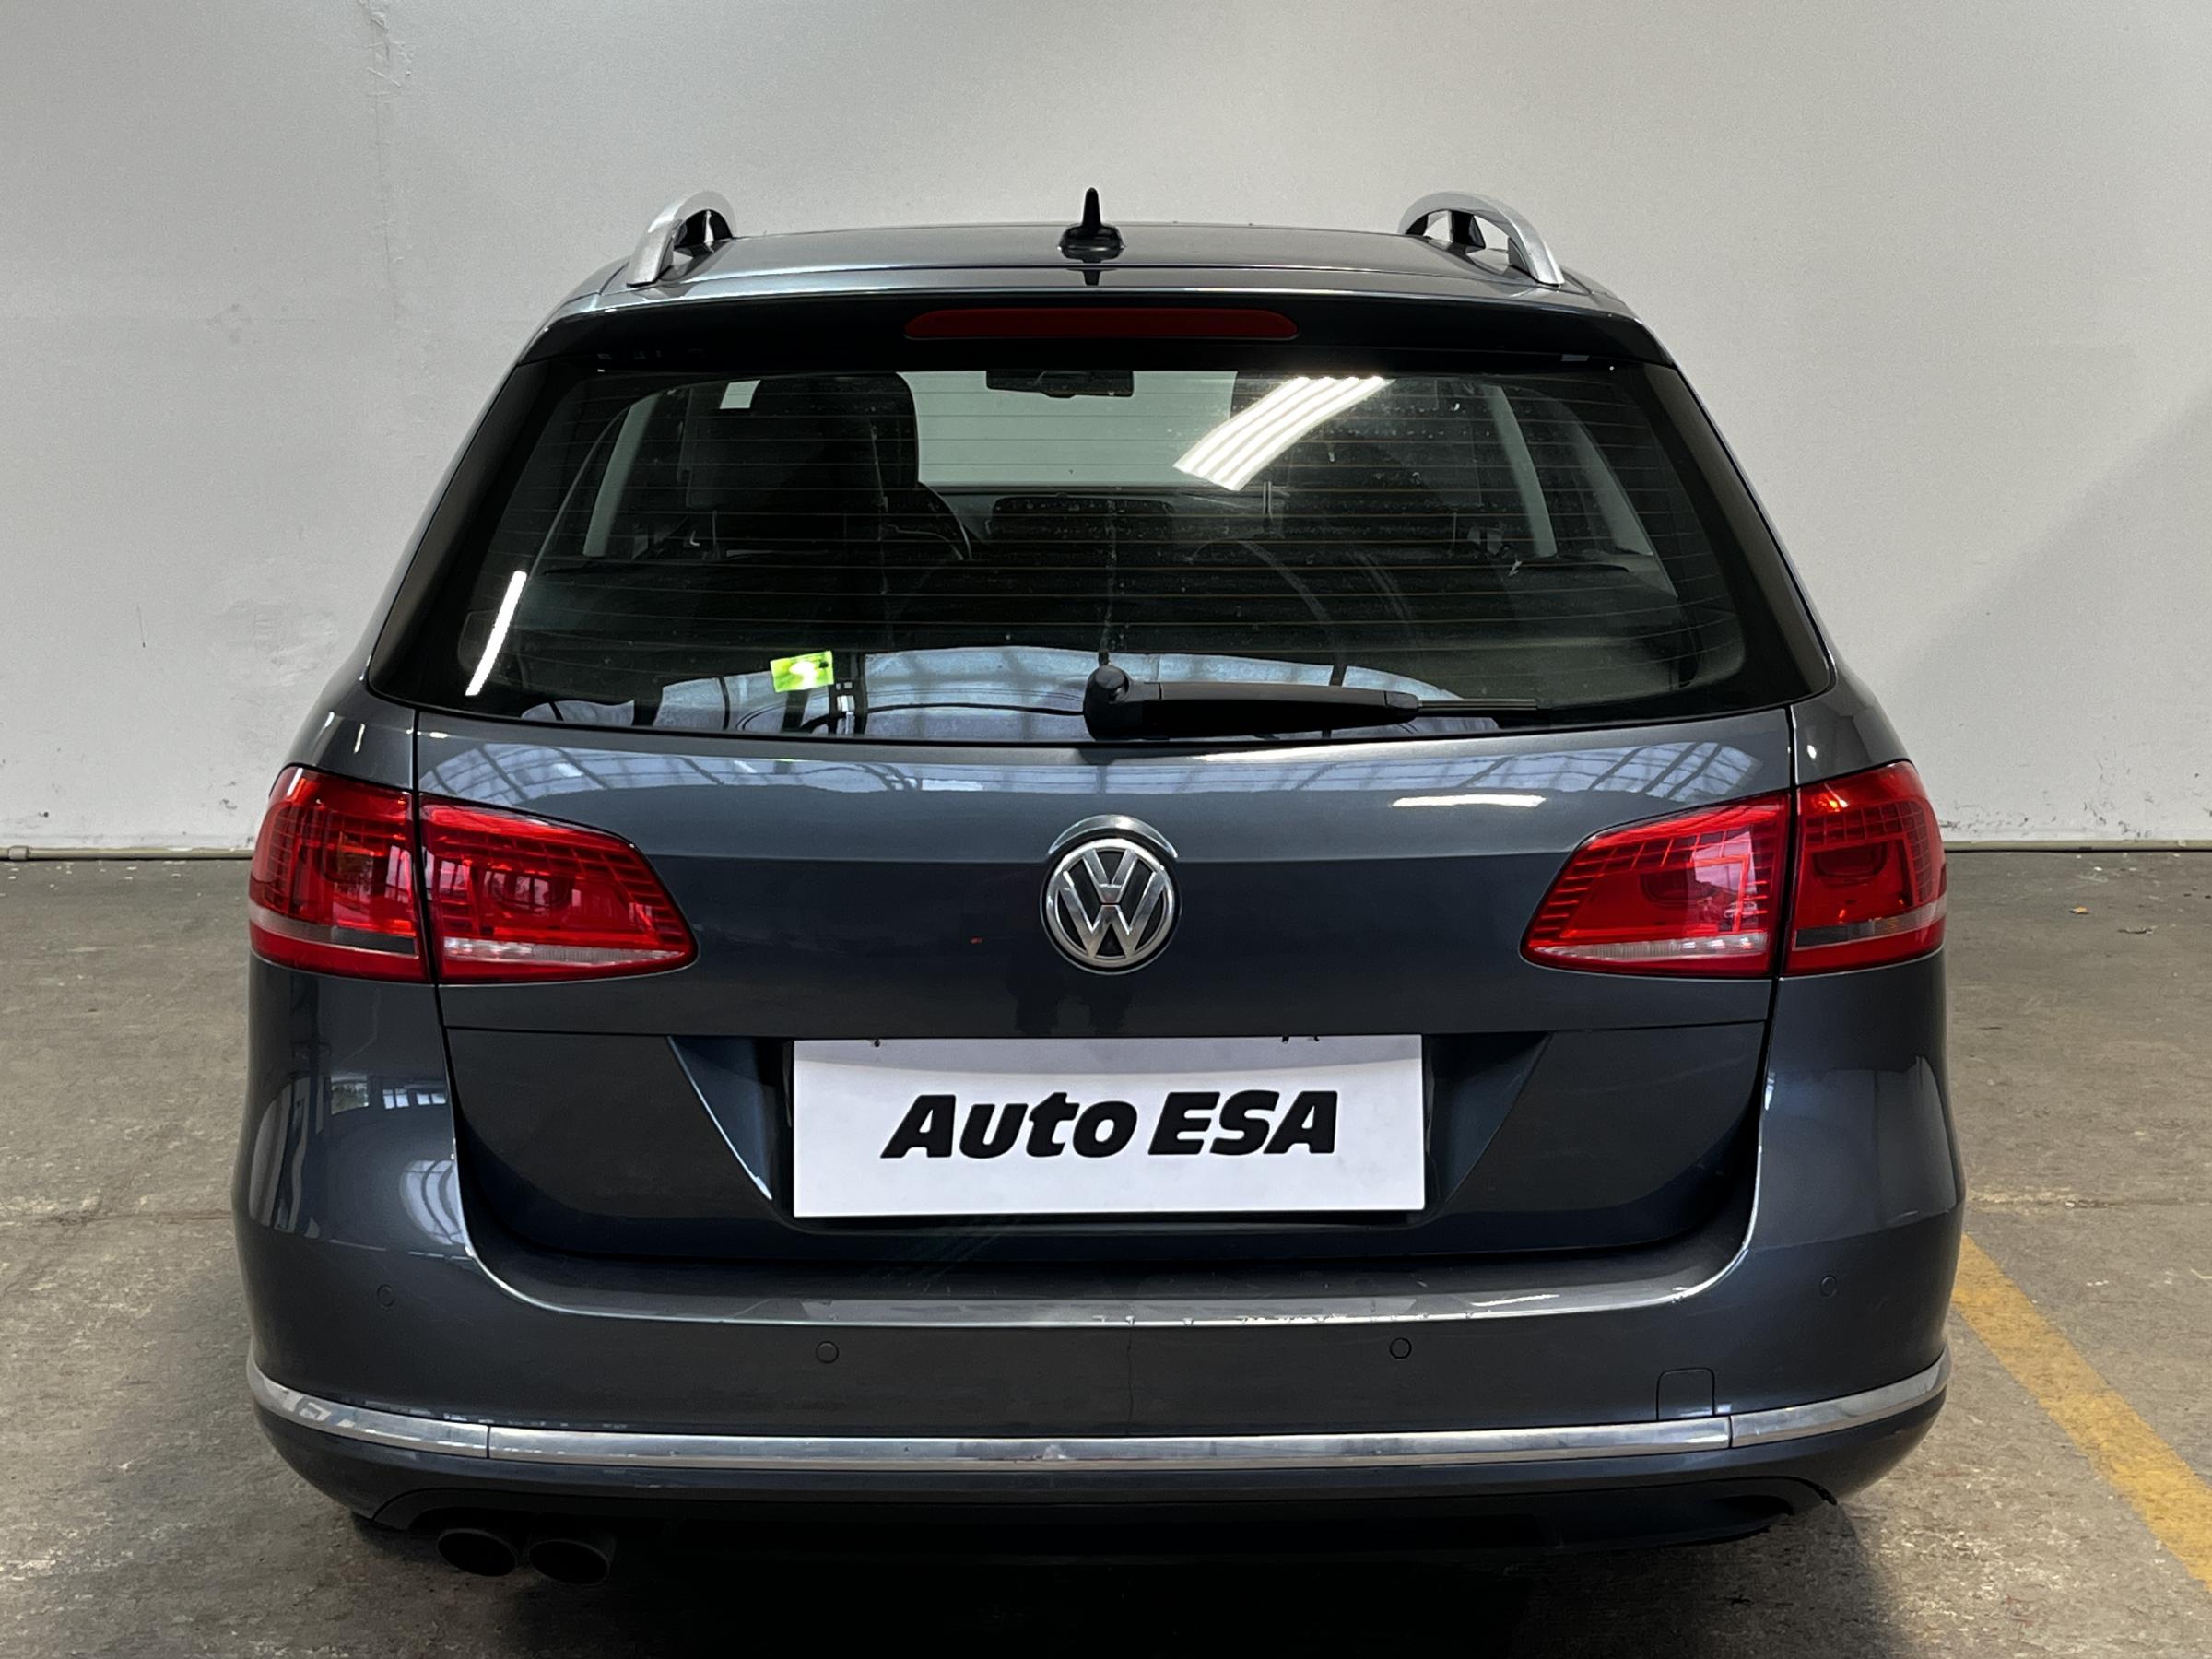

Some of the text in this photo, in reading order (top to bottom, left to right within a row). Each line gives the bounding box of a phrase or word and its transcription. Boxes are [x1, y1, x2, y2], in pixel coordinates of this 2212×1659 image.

[1051, 842, 1171, 962] VW
[880, 1089, 1338, 1159] Auto ESA
